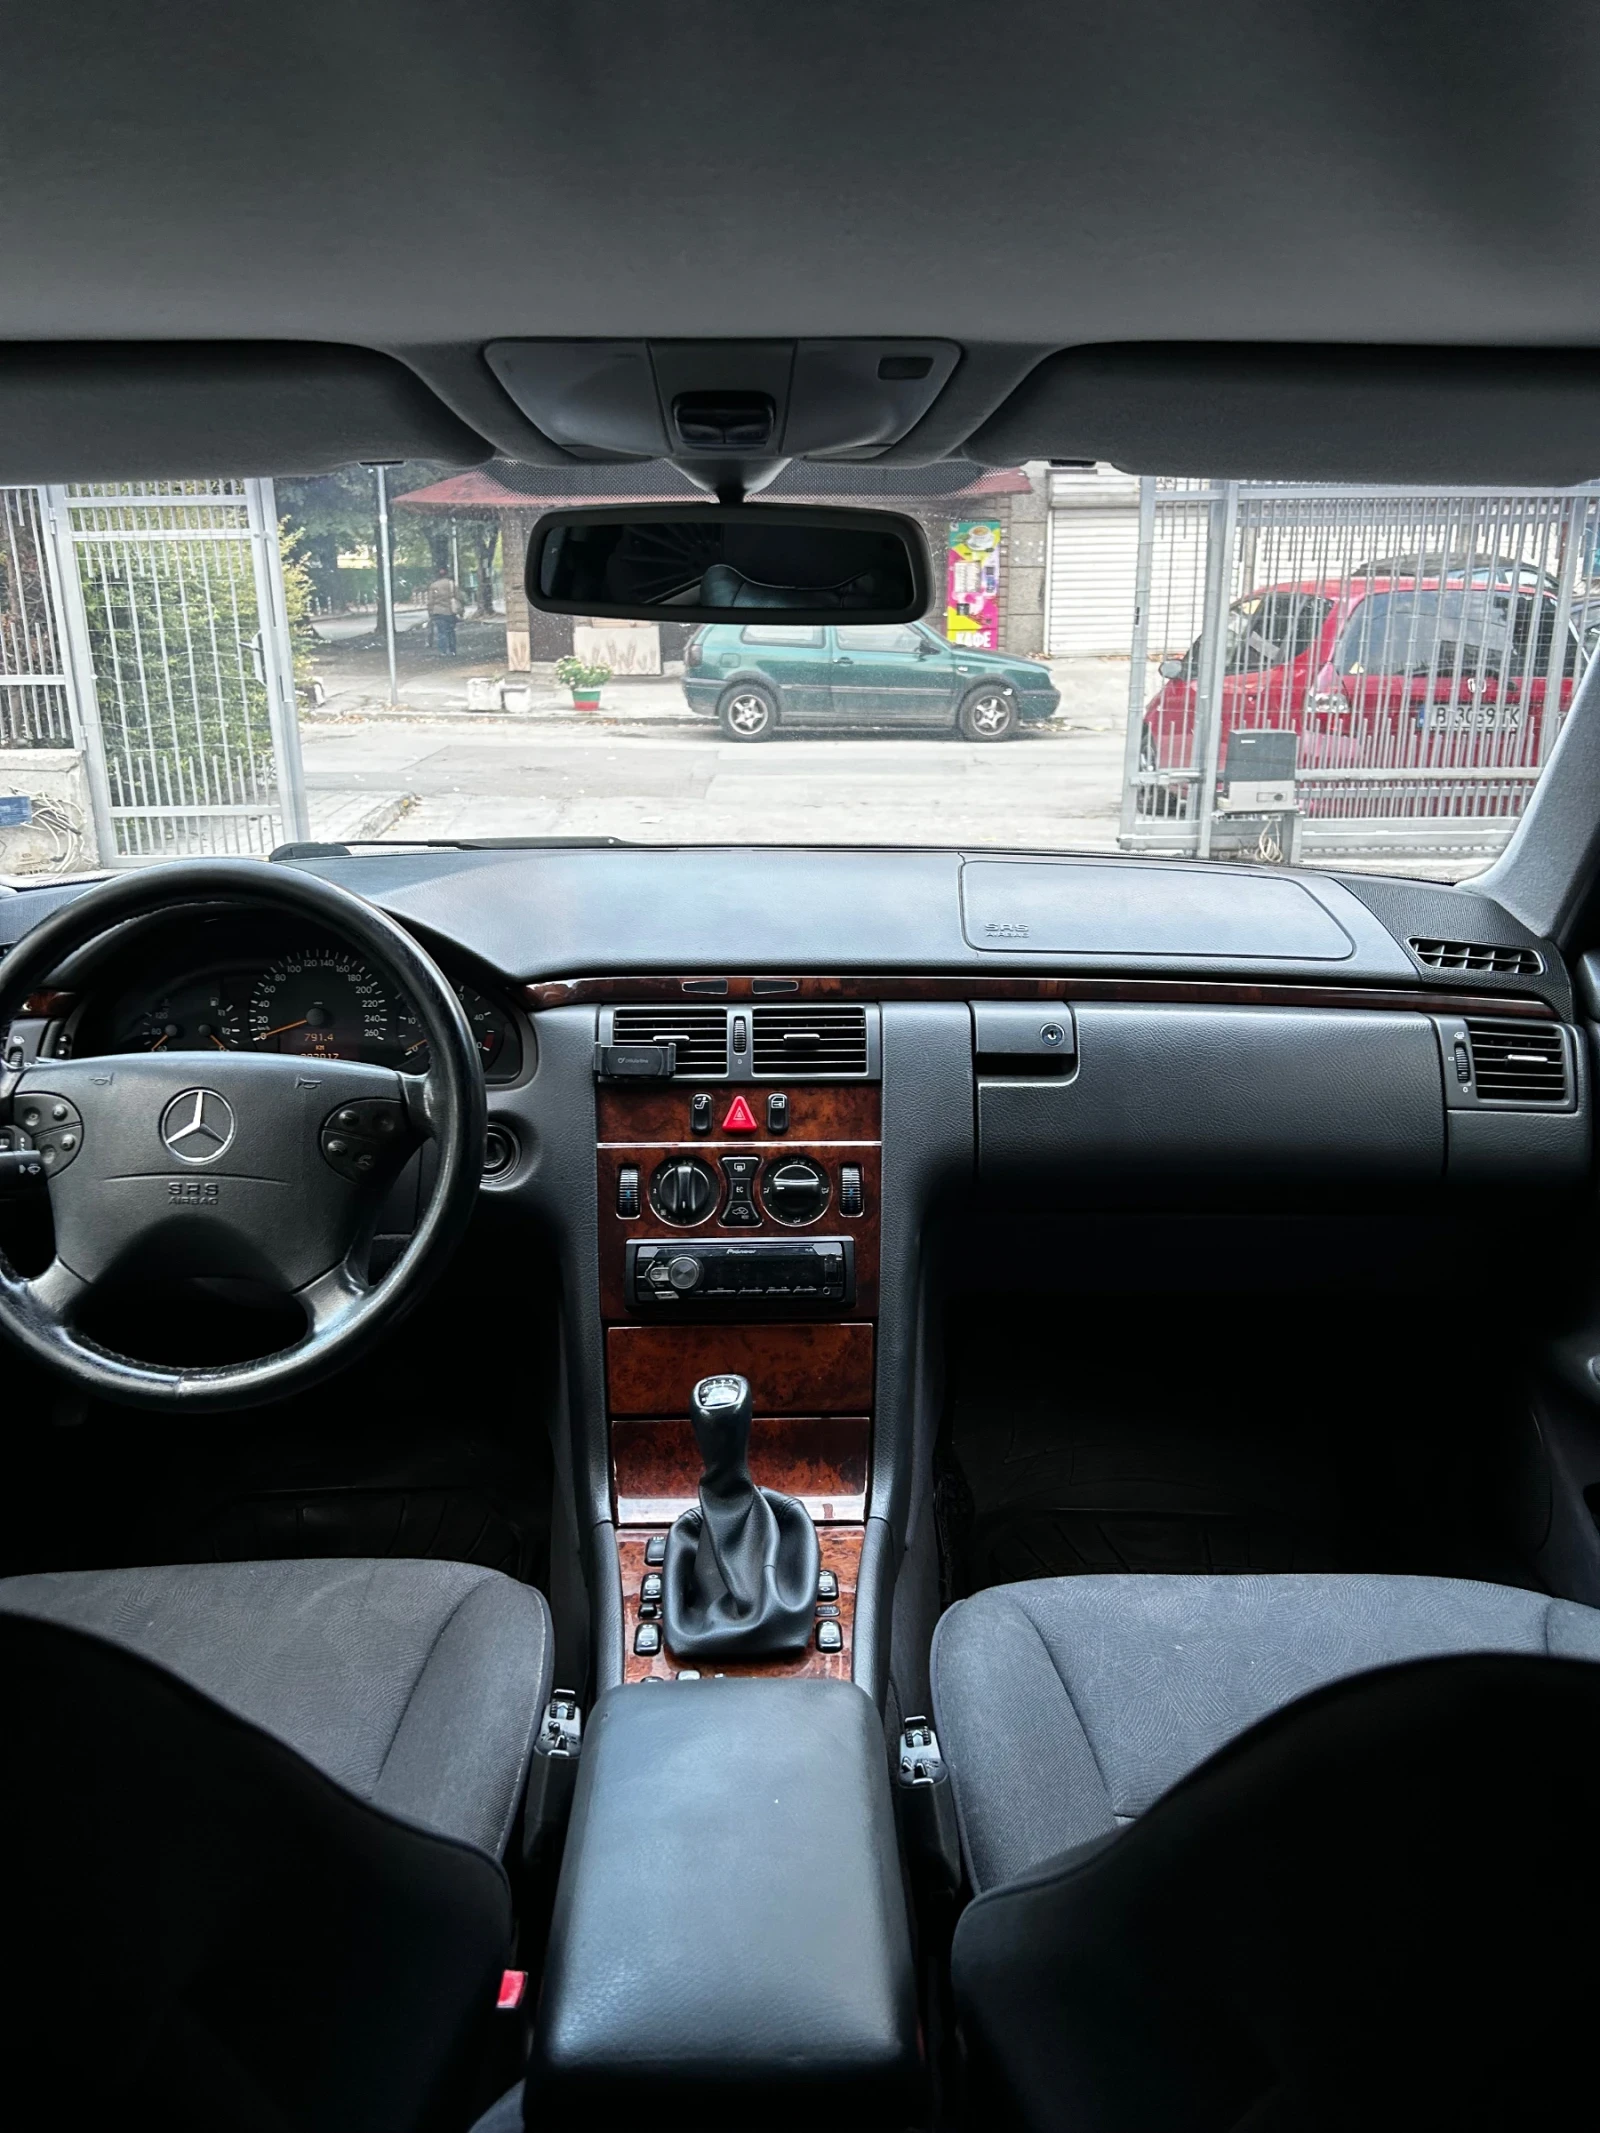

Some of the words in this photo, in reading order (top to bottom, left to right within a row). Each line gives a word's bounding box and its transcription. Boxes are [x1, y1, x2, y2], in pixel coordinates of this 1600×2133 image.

[956, 631, 991, 648] КАФЕ
[984, 923, 1030, 932] SRS
[287, 965, 302, 973] 100
[335, 965, 350, 973] 160
[264, 985, 276, 993] 60
[355, 986, 373, 994] 200
[258, 1000, 270, 1008] 40
[361, 1000, 379, 1008] 220
[257, 1015, 269, 1023] 20
[364, 1029, 380, 1037] 260
[304, 1033, 334, 1042] 791.4
[168, 1182, 219, 1195] SRS
